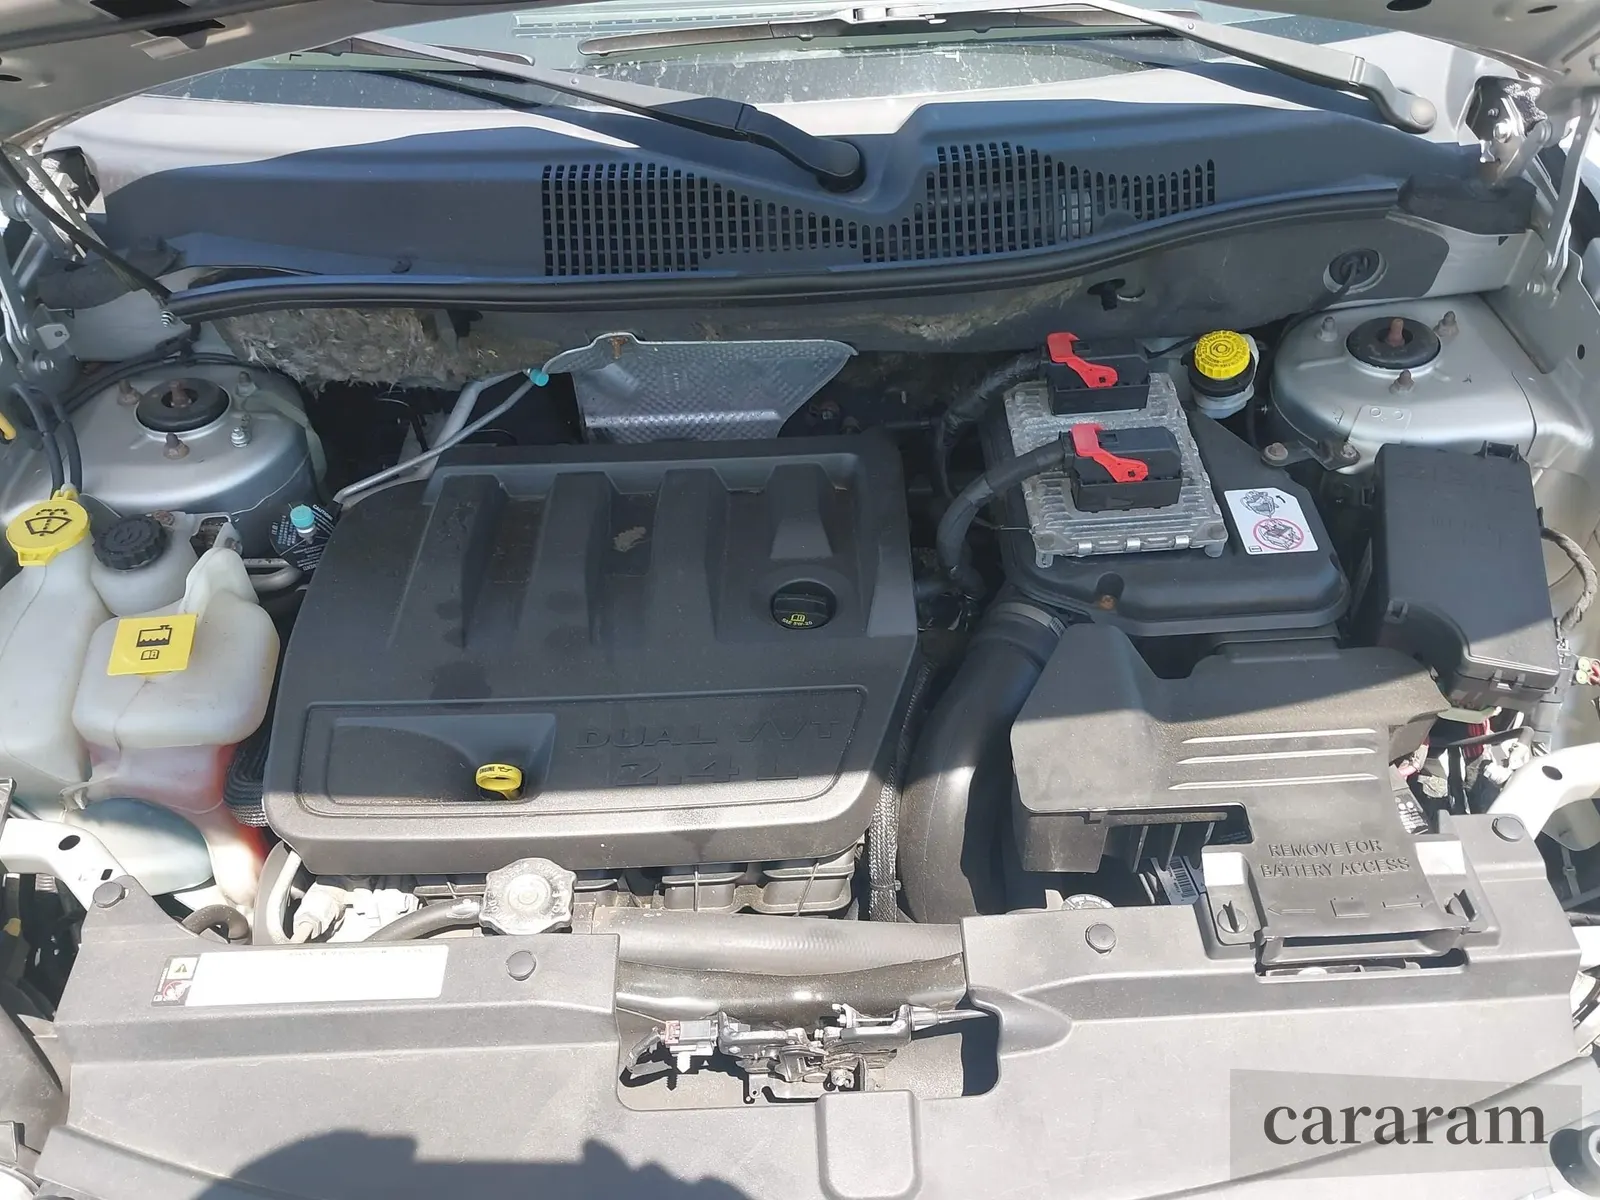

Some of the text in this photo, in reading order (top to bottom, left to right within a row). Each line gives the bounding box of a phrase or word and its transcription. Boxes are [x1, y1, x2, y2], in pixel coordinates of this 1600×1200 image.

[575, 726, 718, 749] DUAL
[1268, 838, 1383, 859] REMOVE FOR
[1260, 857, 1411, 879] BATTERY ACCESS
